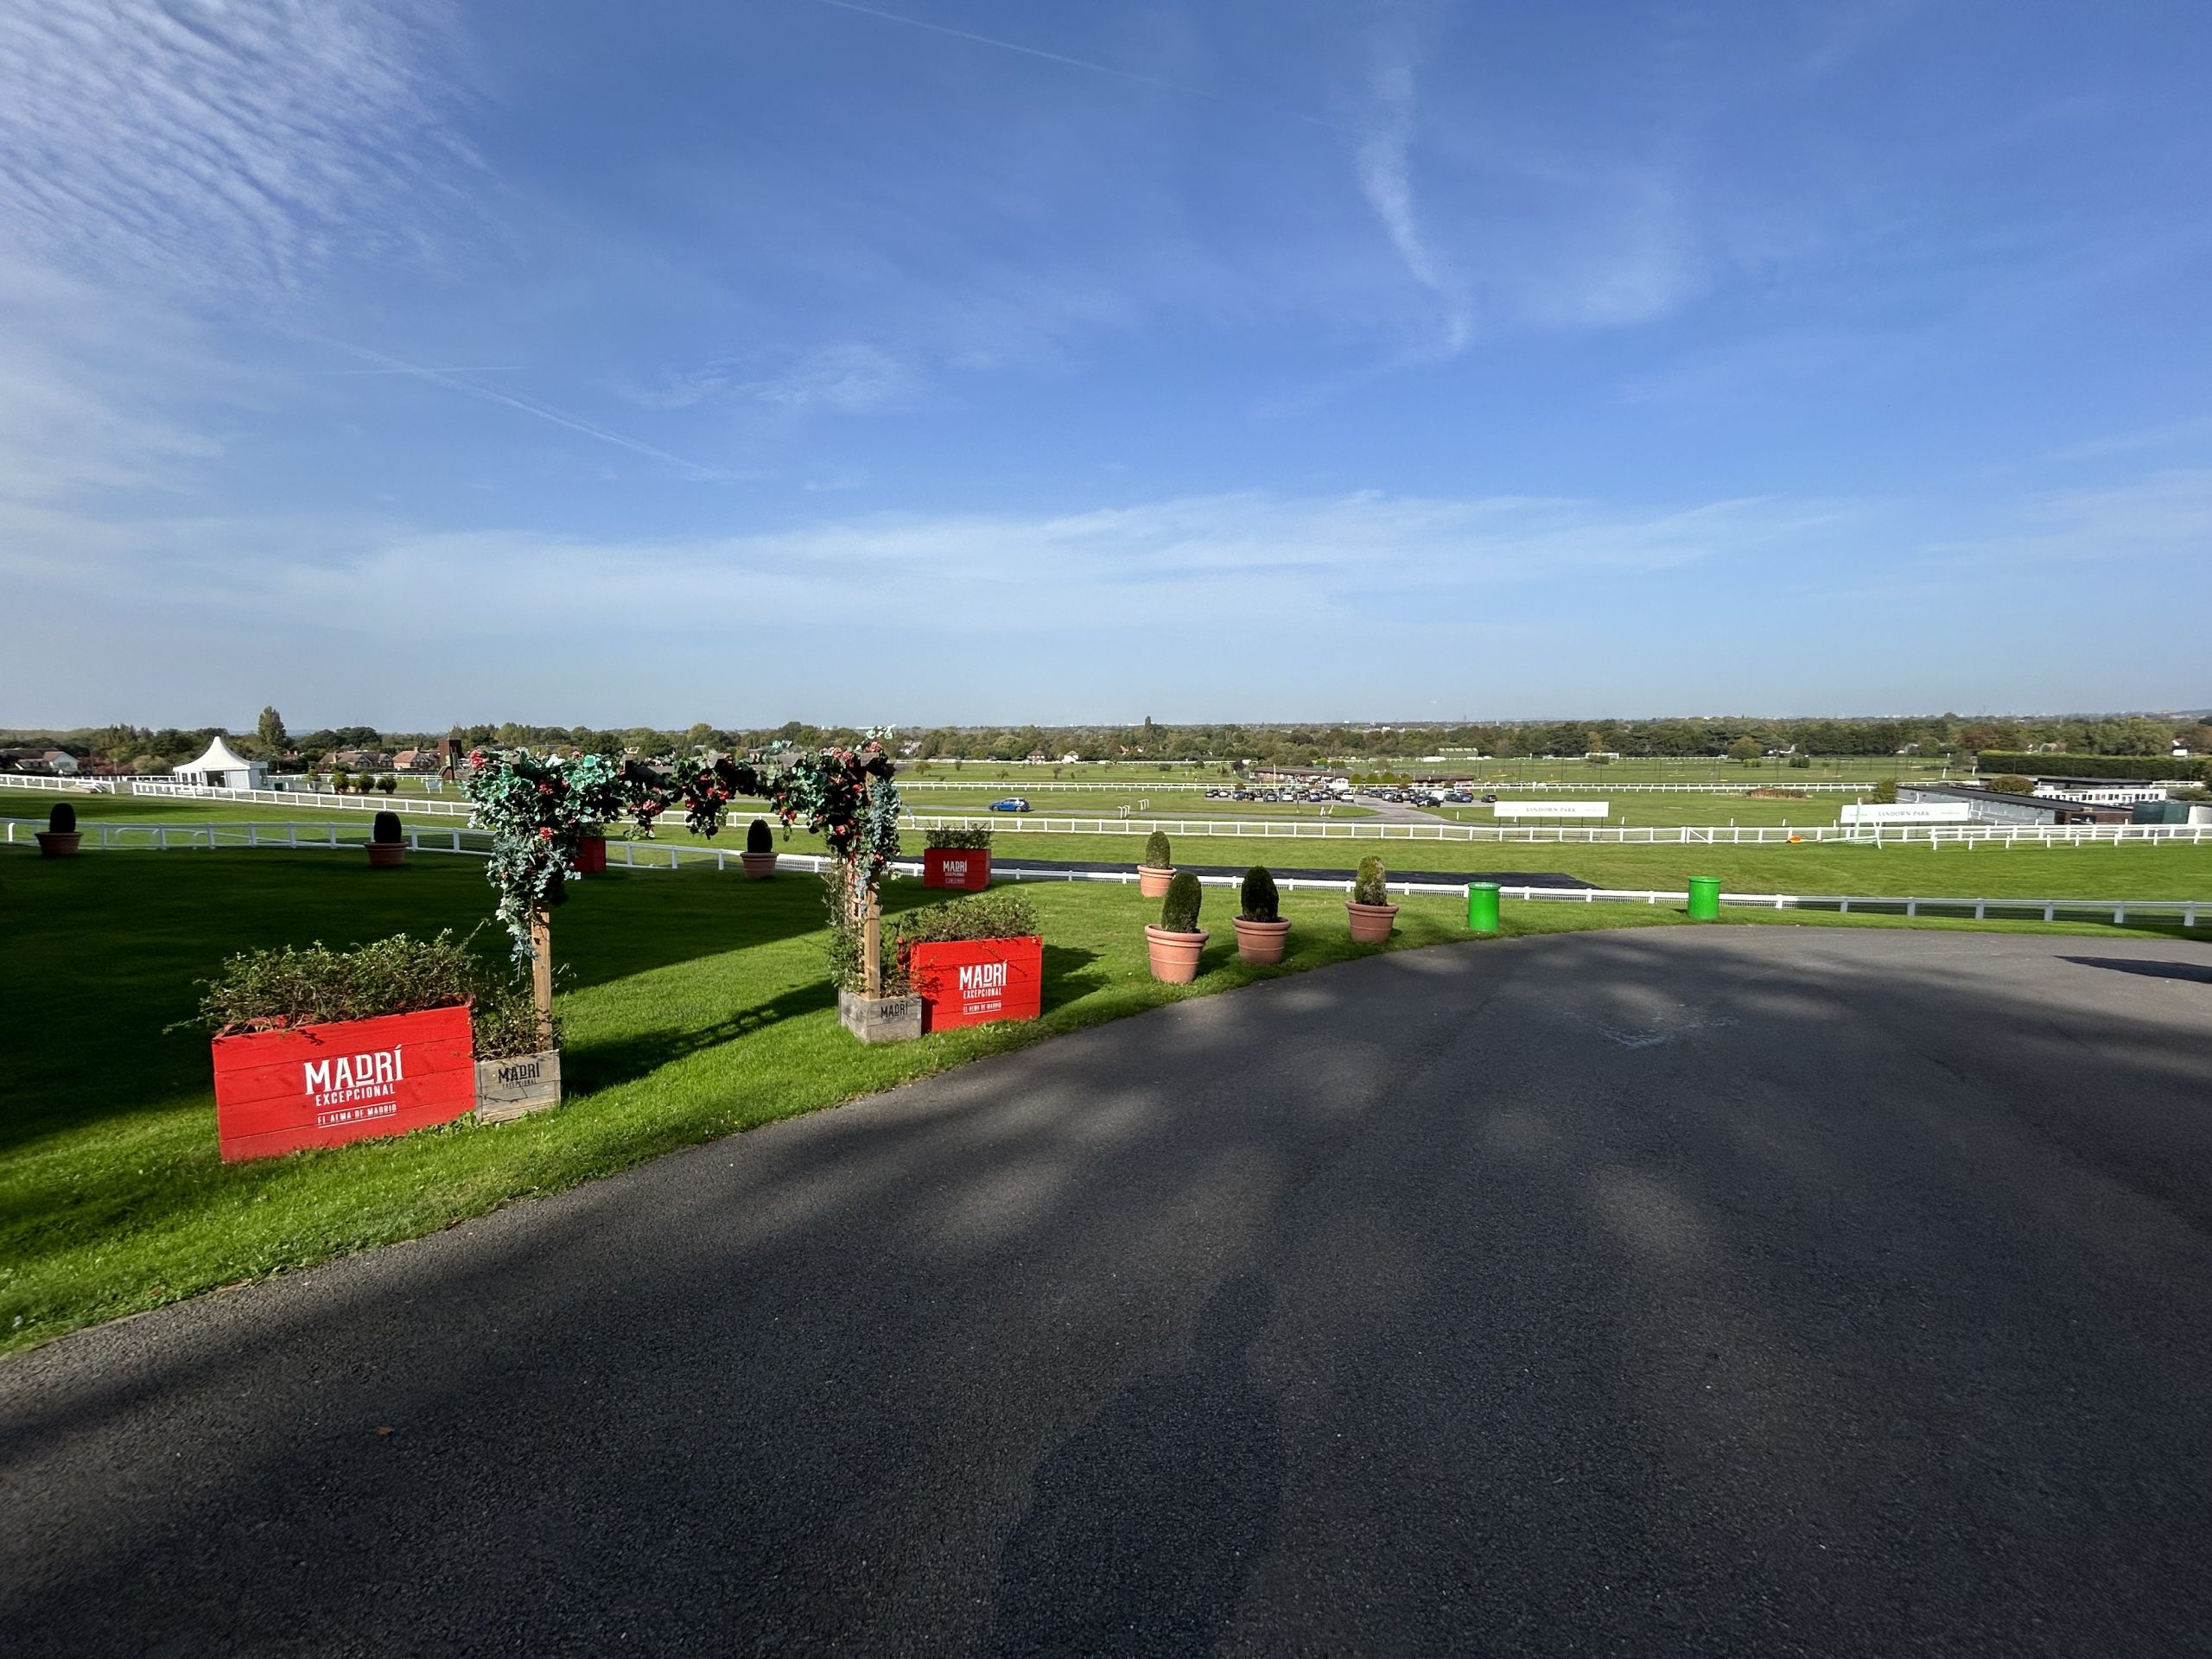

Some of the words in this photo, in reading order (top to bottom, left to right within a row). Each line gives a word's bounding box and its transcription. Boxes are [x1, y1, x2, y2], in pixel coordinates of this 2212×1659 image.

[959, 959, 1007, 991] MADRÍ
[963, 987, 1002, 1000] EXCEPCIONAL
[303, 1044, 404, 1095] MADRÍ
[315, 1084, 396, 1107] EXCEPCIONAL
[367, 1103, 397, 1116] MADRID
